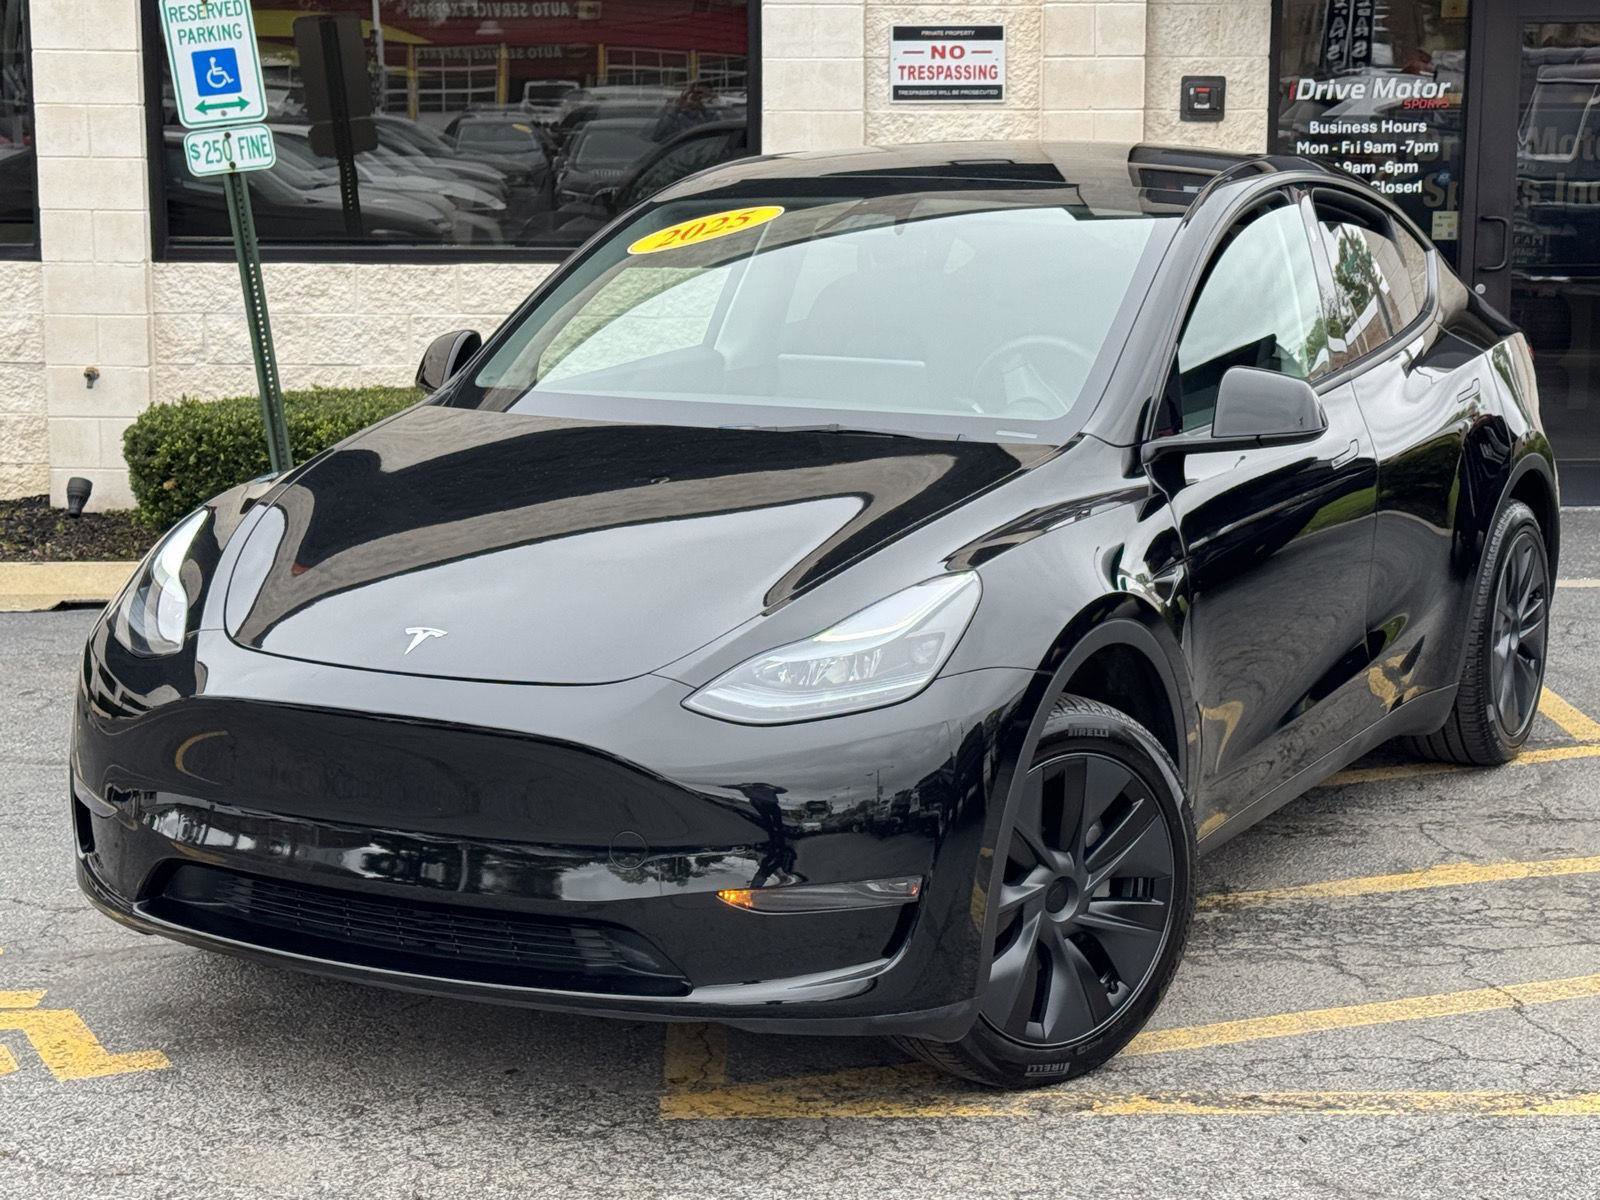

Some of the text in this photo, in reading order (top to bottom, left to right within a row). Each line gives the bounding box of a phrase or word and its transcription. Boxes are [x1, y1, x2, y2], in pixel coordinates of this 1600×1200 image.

[168, 0, 243, 23] RESERVED
[177, 23, 243, 45] PARKING
[931, 45, 965, 60] NO
[898, 65, 998, 80] TRESPASSING
[1373, 77, 1451, 99] Motor
[1403, 98, 1450, 110] SPORTS
[1309, 120, 1428, 134] Business Hours
[190, 134, 271, 165] $250 FINE
[1296, 141, 1329, 154] Mon
[1341, 141, 1361, 154] Fri
[1364, 140, 1397, 154] 9am
[1400, 140, 1439, 155] -7pm
[1379, 161, 1419, 176] -6pm
[655, 210, 757, 249] 2025
[1025, 1062, 1071, 1077] PIRELLI
